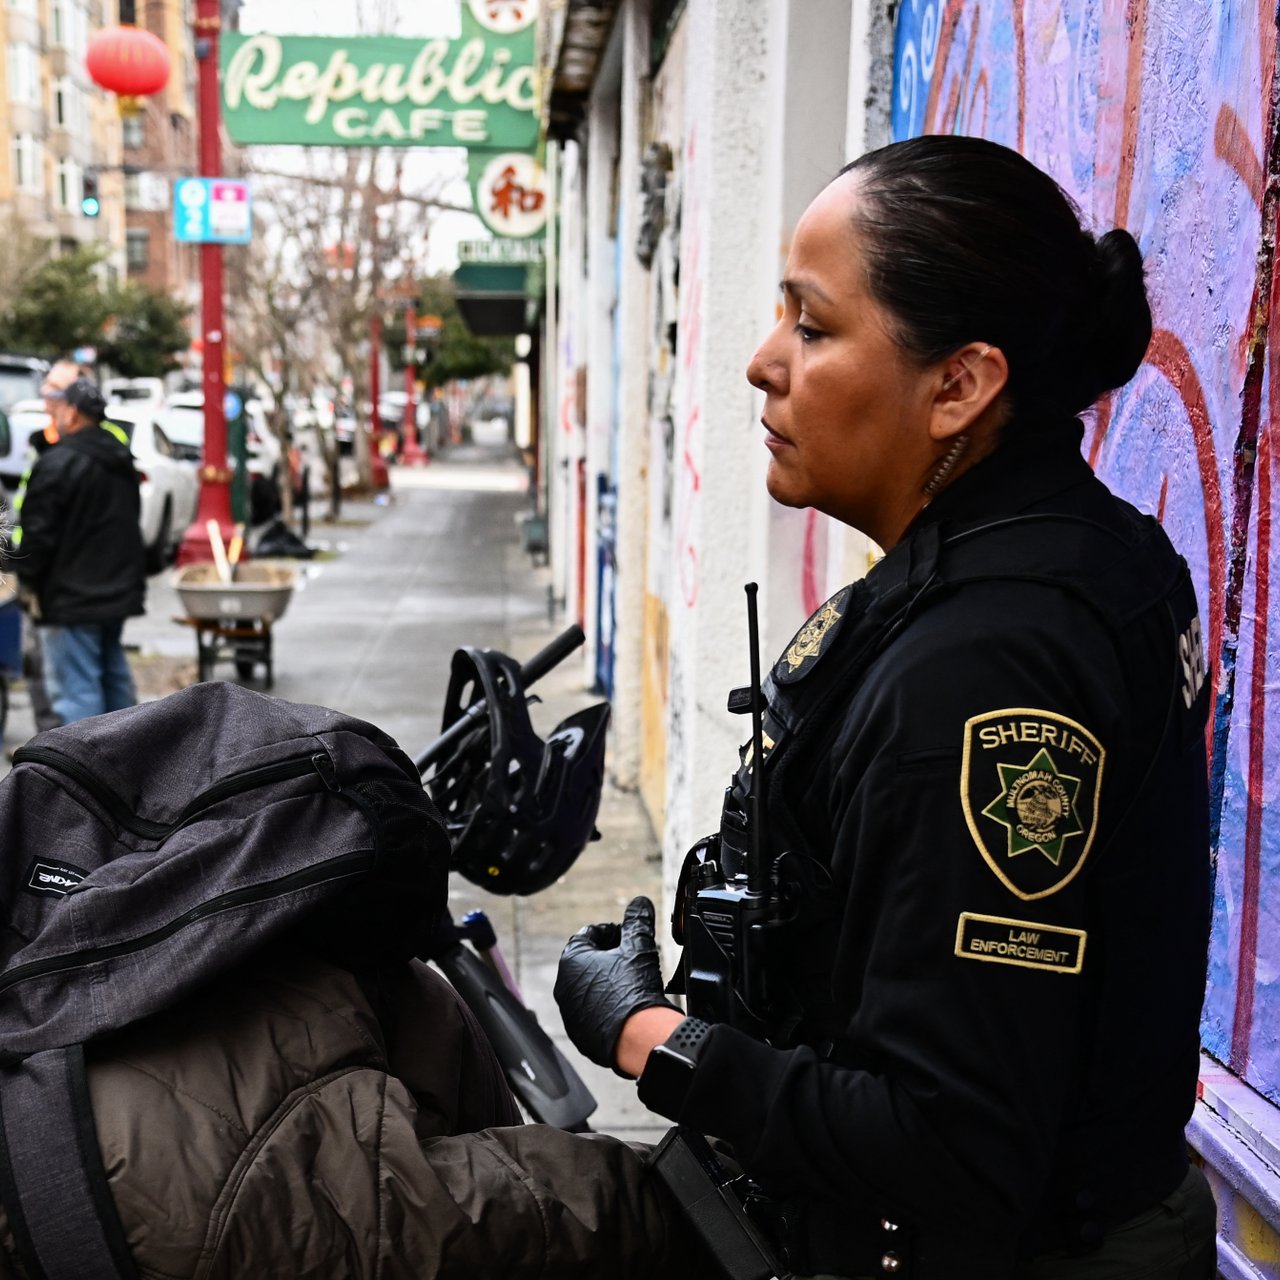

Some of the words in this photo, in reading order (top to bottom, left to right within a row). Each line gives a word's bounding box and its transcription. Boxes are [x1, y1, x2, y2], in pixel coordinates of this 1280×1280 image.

[226, 35, 538, 124] Republic
[333, 107, 488, 141] CAFE
[978, 722, 1097, 766] SHERIFF
[1006, 771, 1052, 808] MULTNOMAH
[1053, 779, 1070, 818] COUNTY
[1016, 824, 1056, 842] OREGON
[970, 939, 1069, 963] ENFORCEMENT
[1008, 930, 1040, 944] LAW
